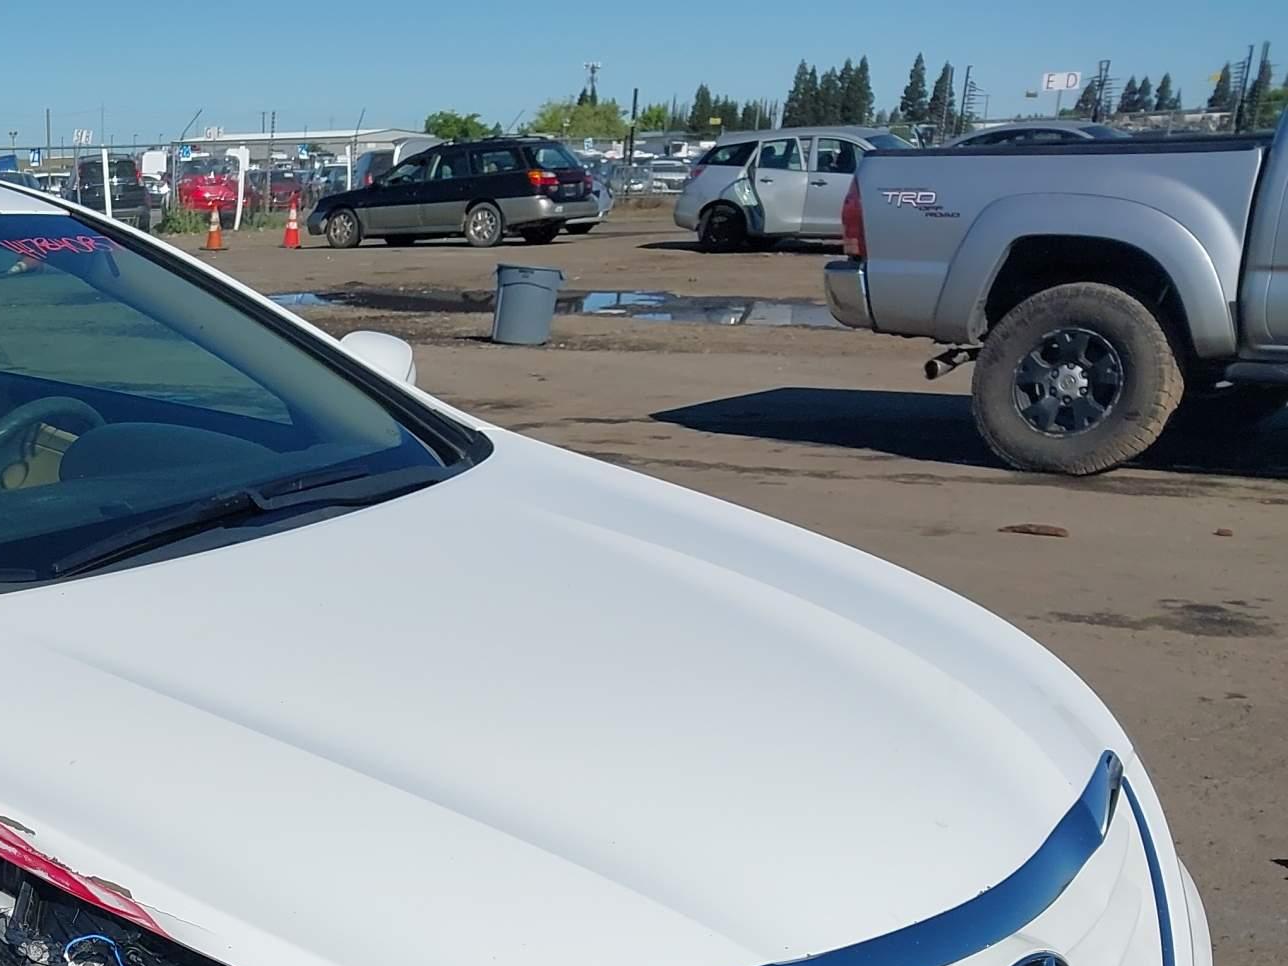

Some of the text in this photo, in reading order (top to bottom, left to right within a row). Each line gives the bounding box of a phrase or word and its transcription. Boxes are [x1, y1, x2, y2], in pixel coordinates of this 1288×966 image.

[1045, 72, 1078, 90] E D
[882, 190, 937, 209] TRD
